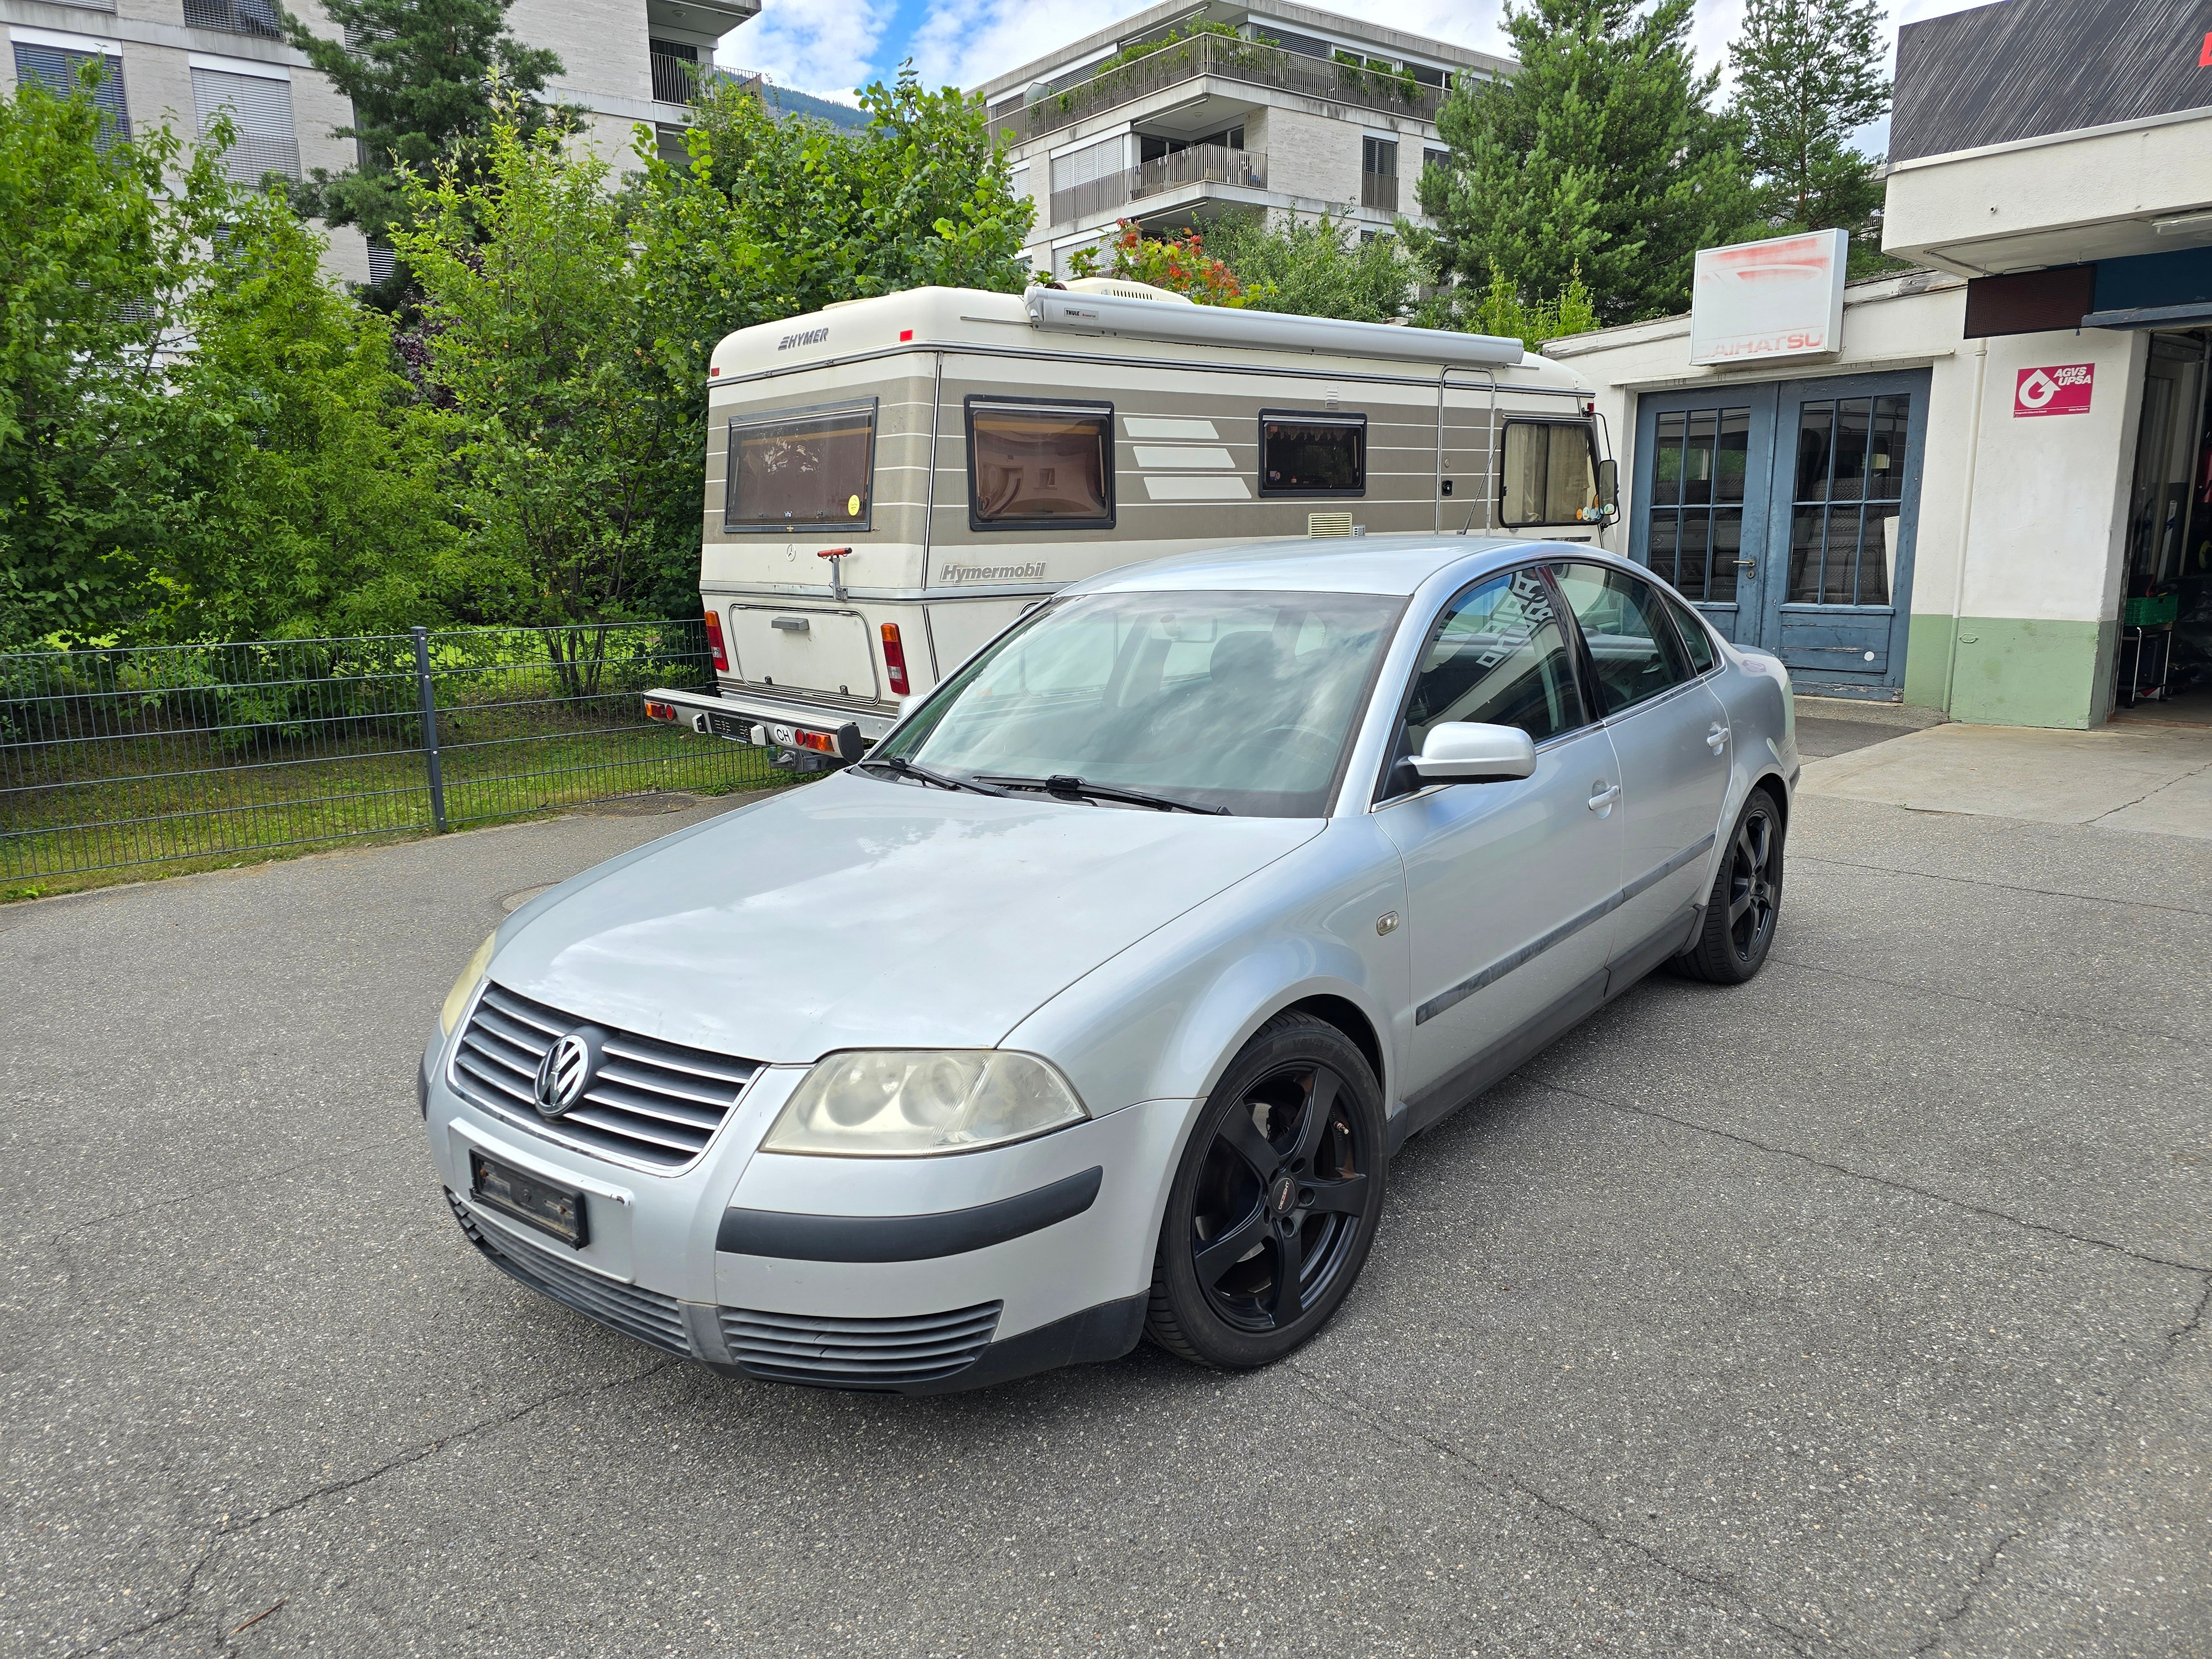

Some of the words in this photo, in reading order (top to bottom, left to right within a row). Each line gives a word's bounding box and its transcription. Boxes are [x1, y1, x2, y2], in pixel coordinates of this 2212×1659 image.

[788, 327, 828, 349] HYMER
[1694, 333, 1824, 359] AIHATSU
[2053, 367, 2087, 378] AGVS
[2058, 375, 2091, 385] UPSA
[941, 562, 1047, 584] Hymermobil
[776, 728, 791, 743] CH
[1278, 1180, 1289, 1210] DEZENT
